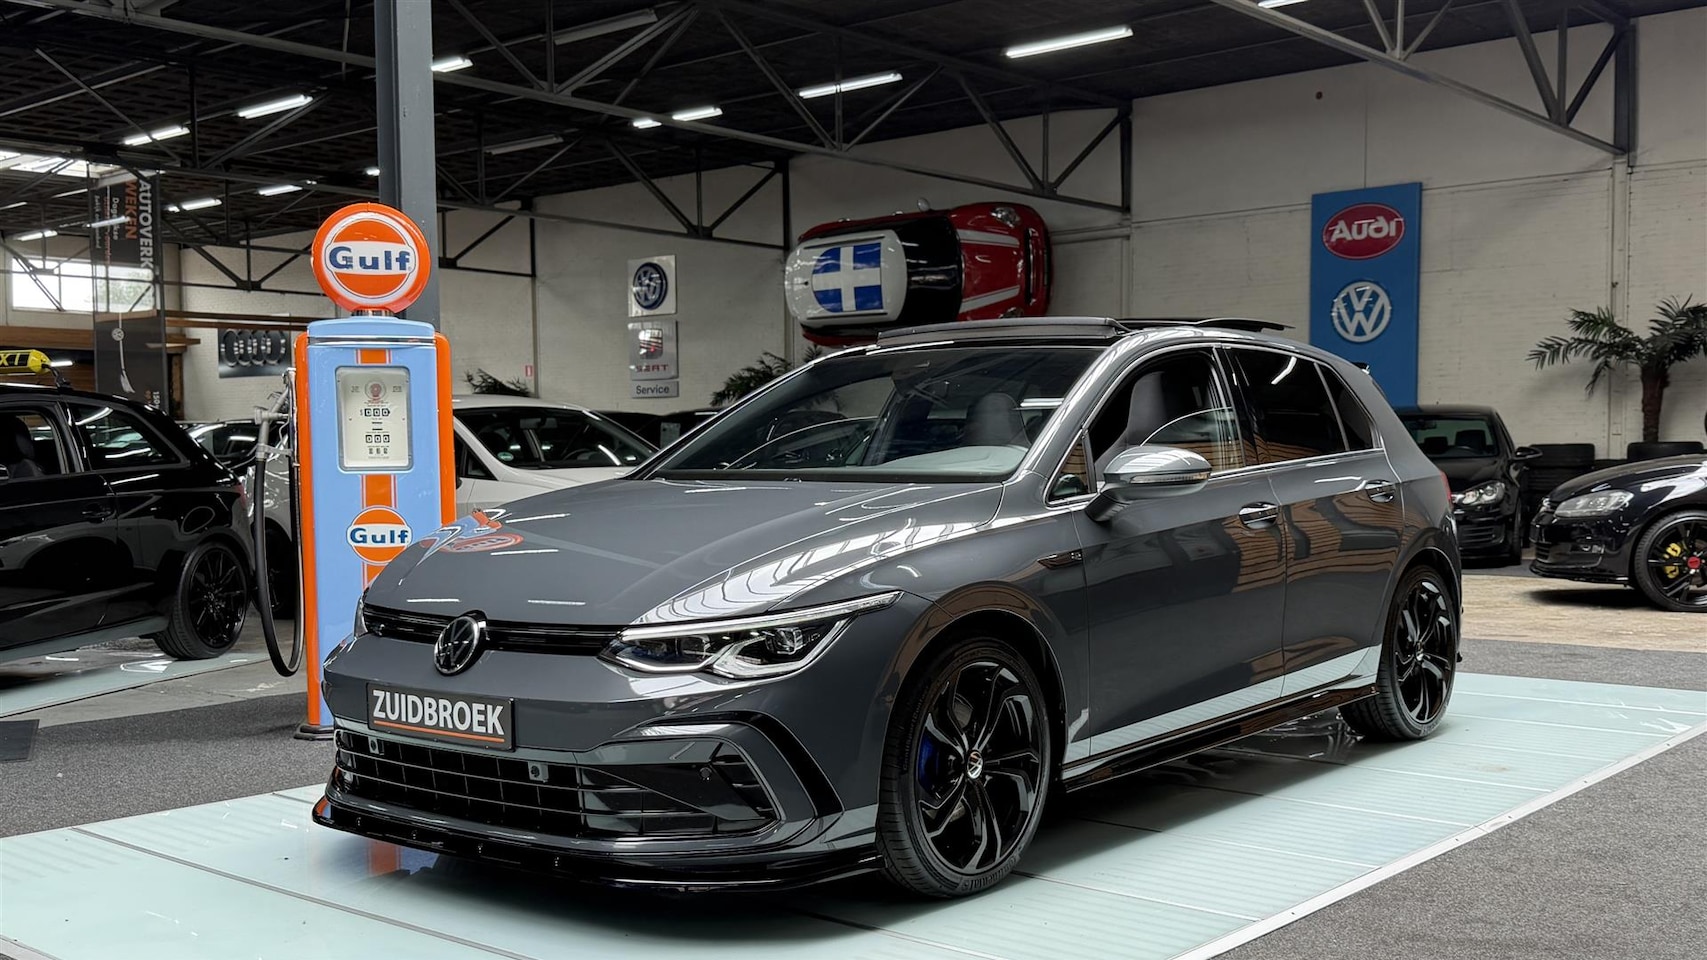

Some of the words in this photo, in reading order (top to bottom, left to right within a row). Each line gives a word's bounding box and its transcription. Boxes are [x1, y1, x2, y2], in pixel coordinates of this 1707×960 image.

[1330, 216, 1398, 242] Audi
[329, 246, 411, 271] Gulf
[636, 384, 670, 395] Service
[350, 527, 409, 544] Gulf
[373, 689, 505, 736] ZUIDBROEK
